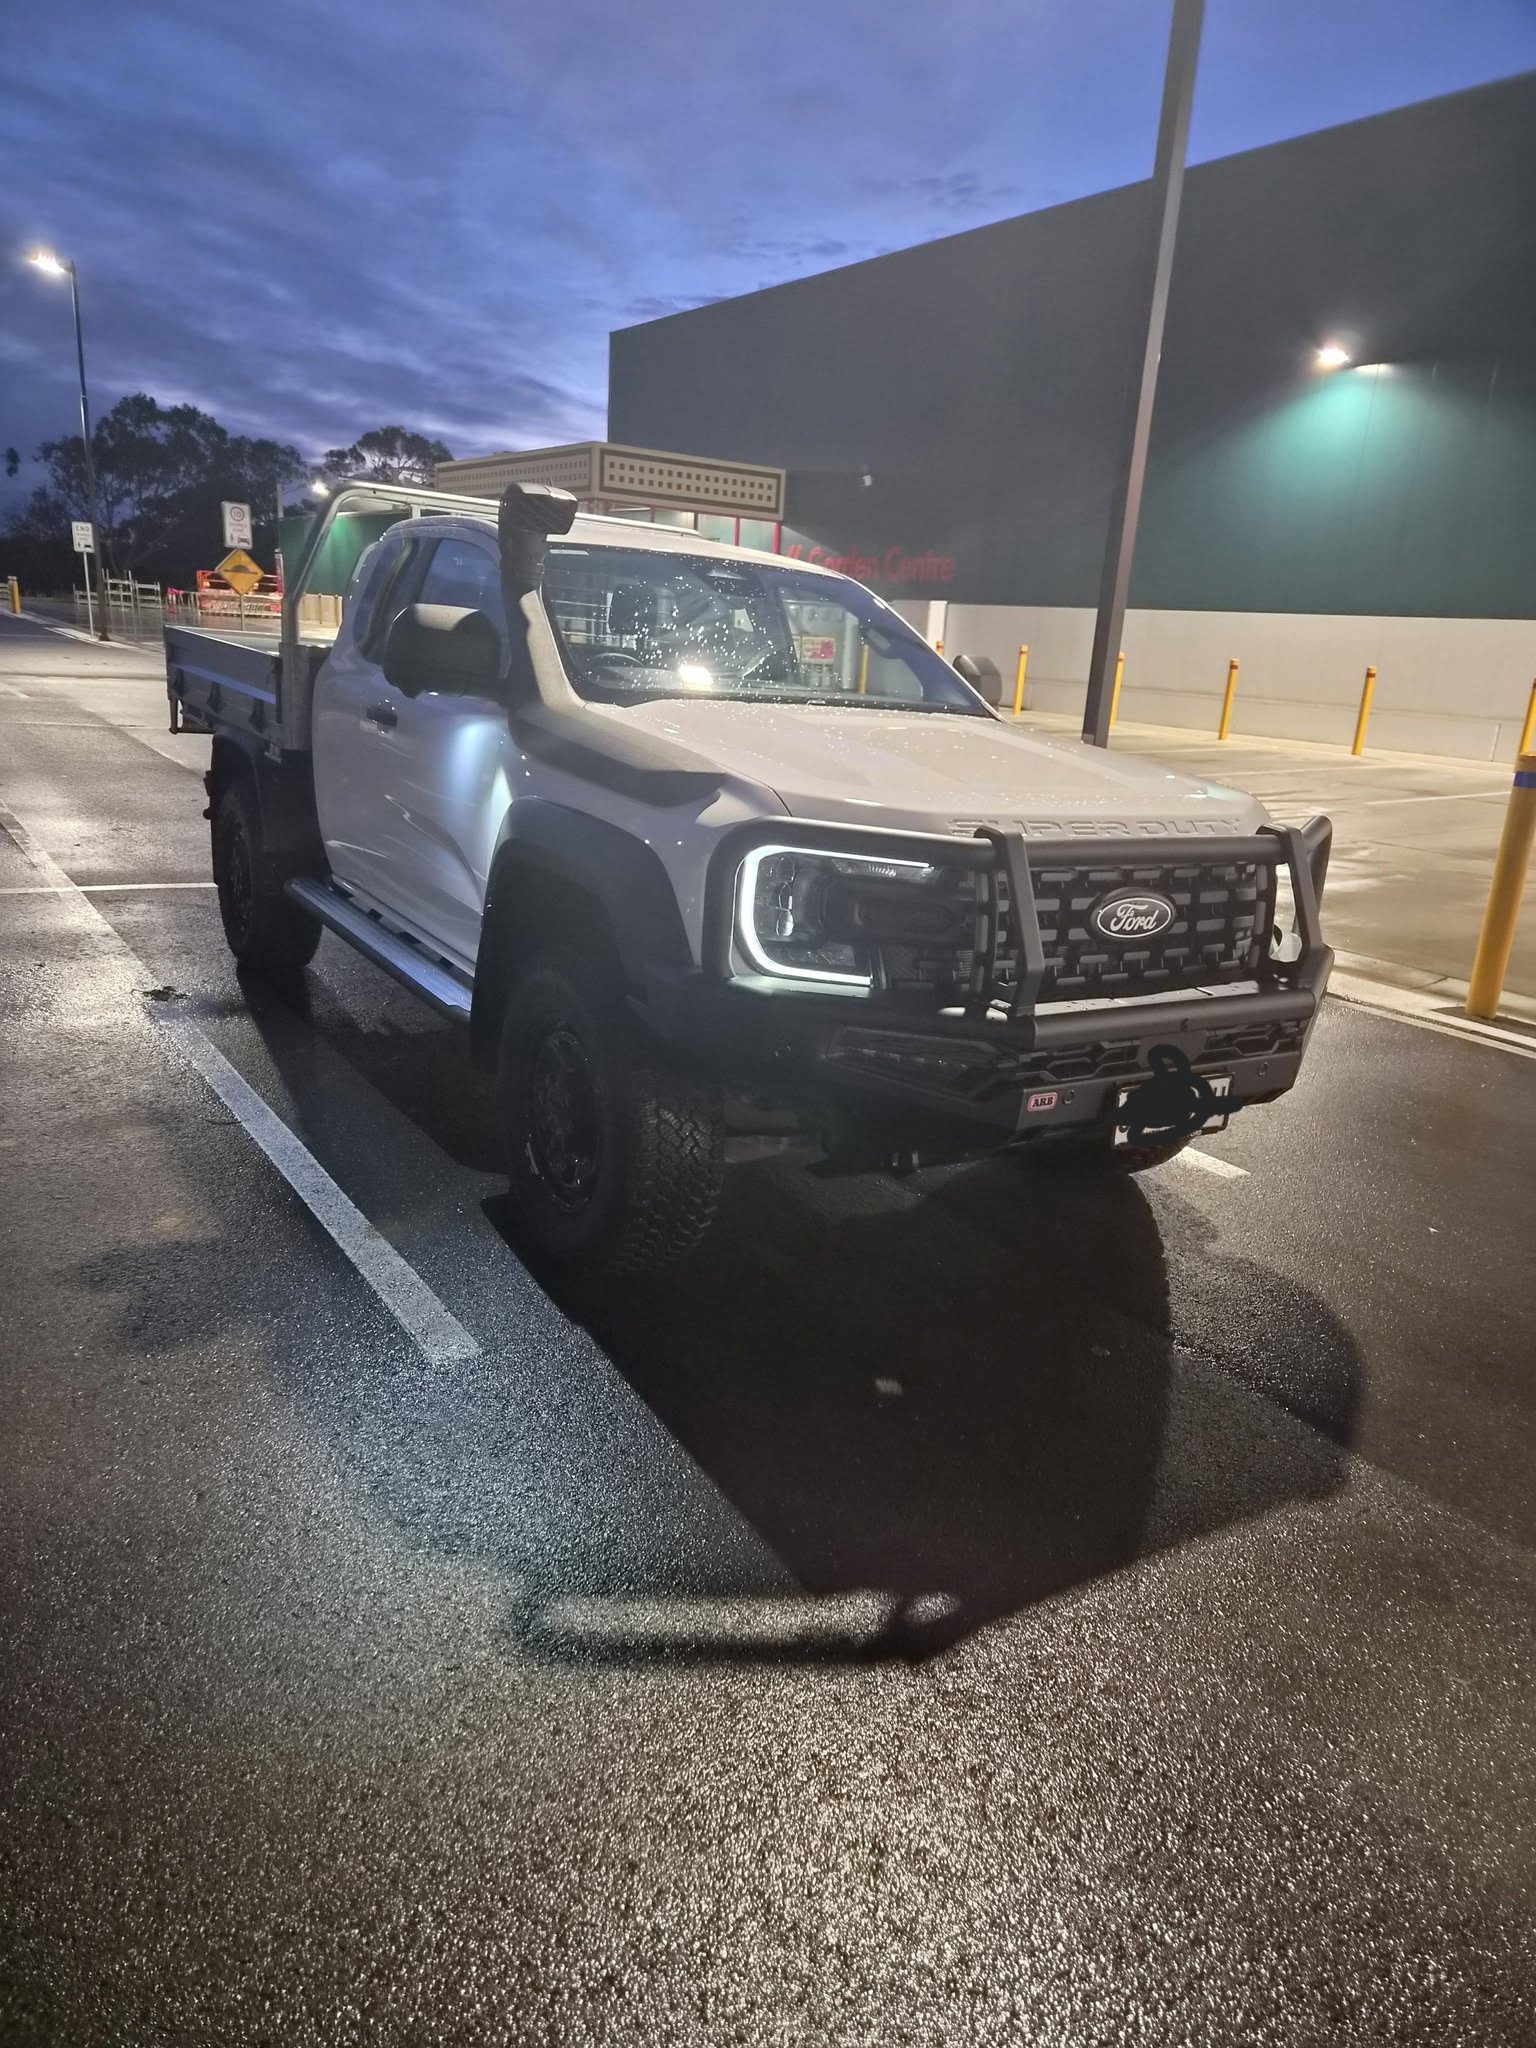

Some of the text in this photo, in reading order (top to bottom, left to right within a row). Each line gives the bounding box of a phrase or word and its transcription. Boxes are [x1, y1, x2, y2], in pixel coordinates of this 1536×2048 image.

[75, 524, 90, 532] END
[882, 544, 954, 582] Centre
[1136, 818, 1240, 836] DUTY
[1110, 903, 1159, 931] Ford
[1031, 1096, 1054, 1108] ARB
